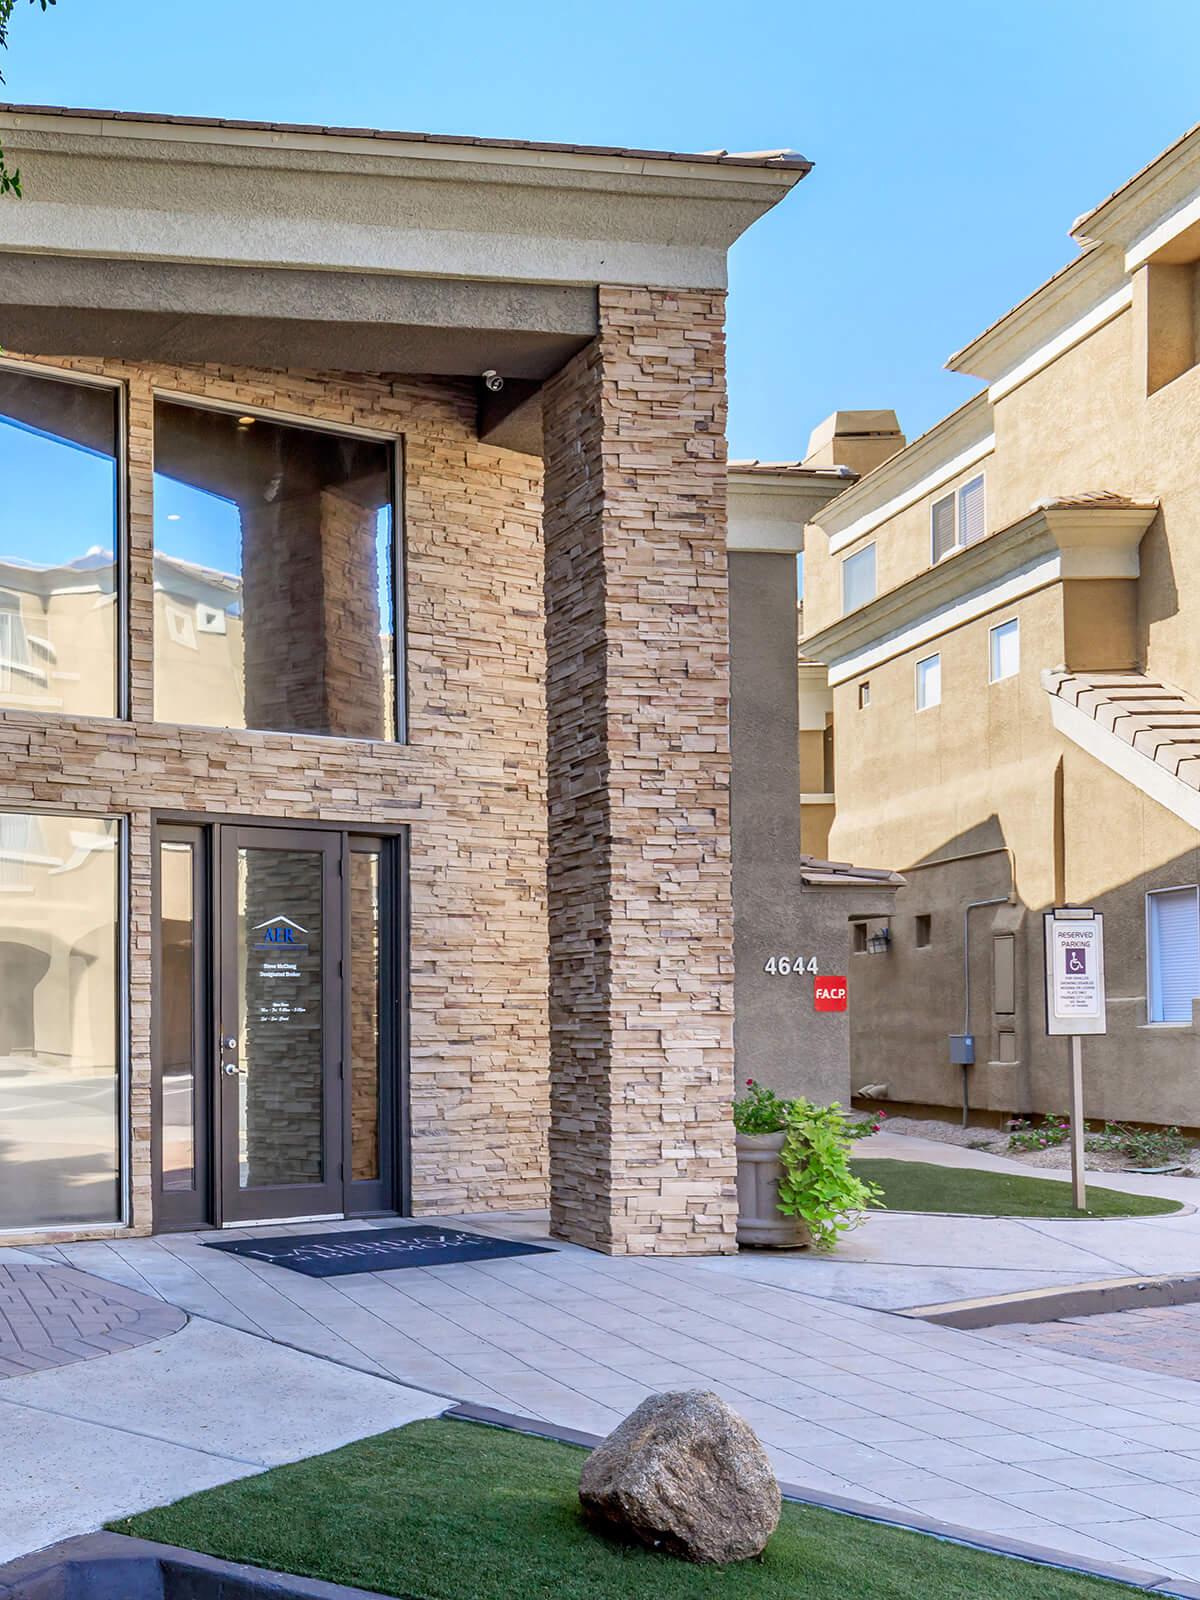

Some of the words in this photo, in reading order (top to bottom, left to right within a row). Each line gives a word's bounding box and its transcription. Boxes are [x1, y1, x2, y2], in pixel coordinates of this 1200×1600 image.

[264, 927, 295, 943] AER
[1057, 931, 1094, 939] RESERVED
[1061, 940, 1092, 948] PARKING
[764, 956, 819, 975] 4644
